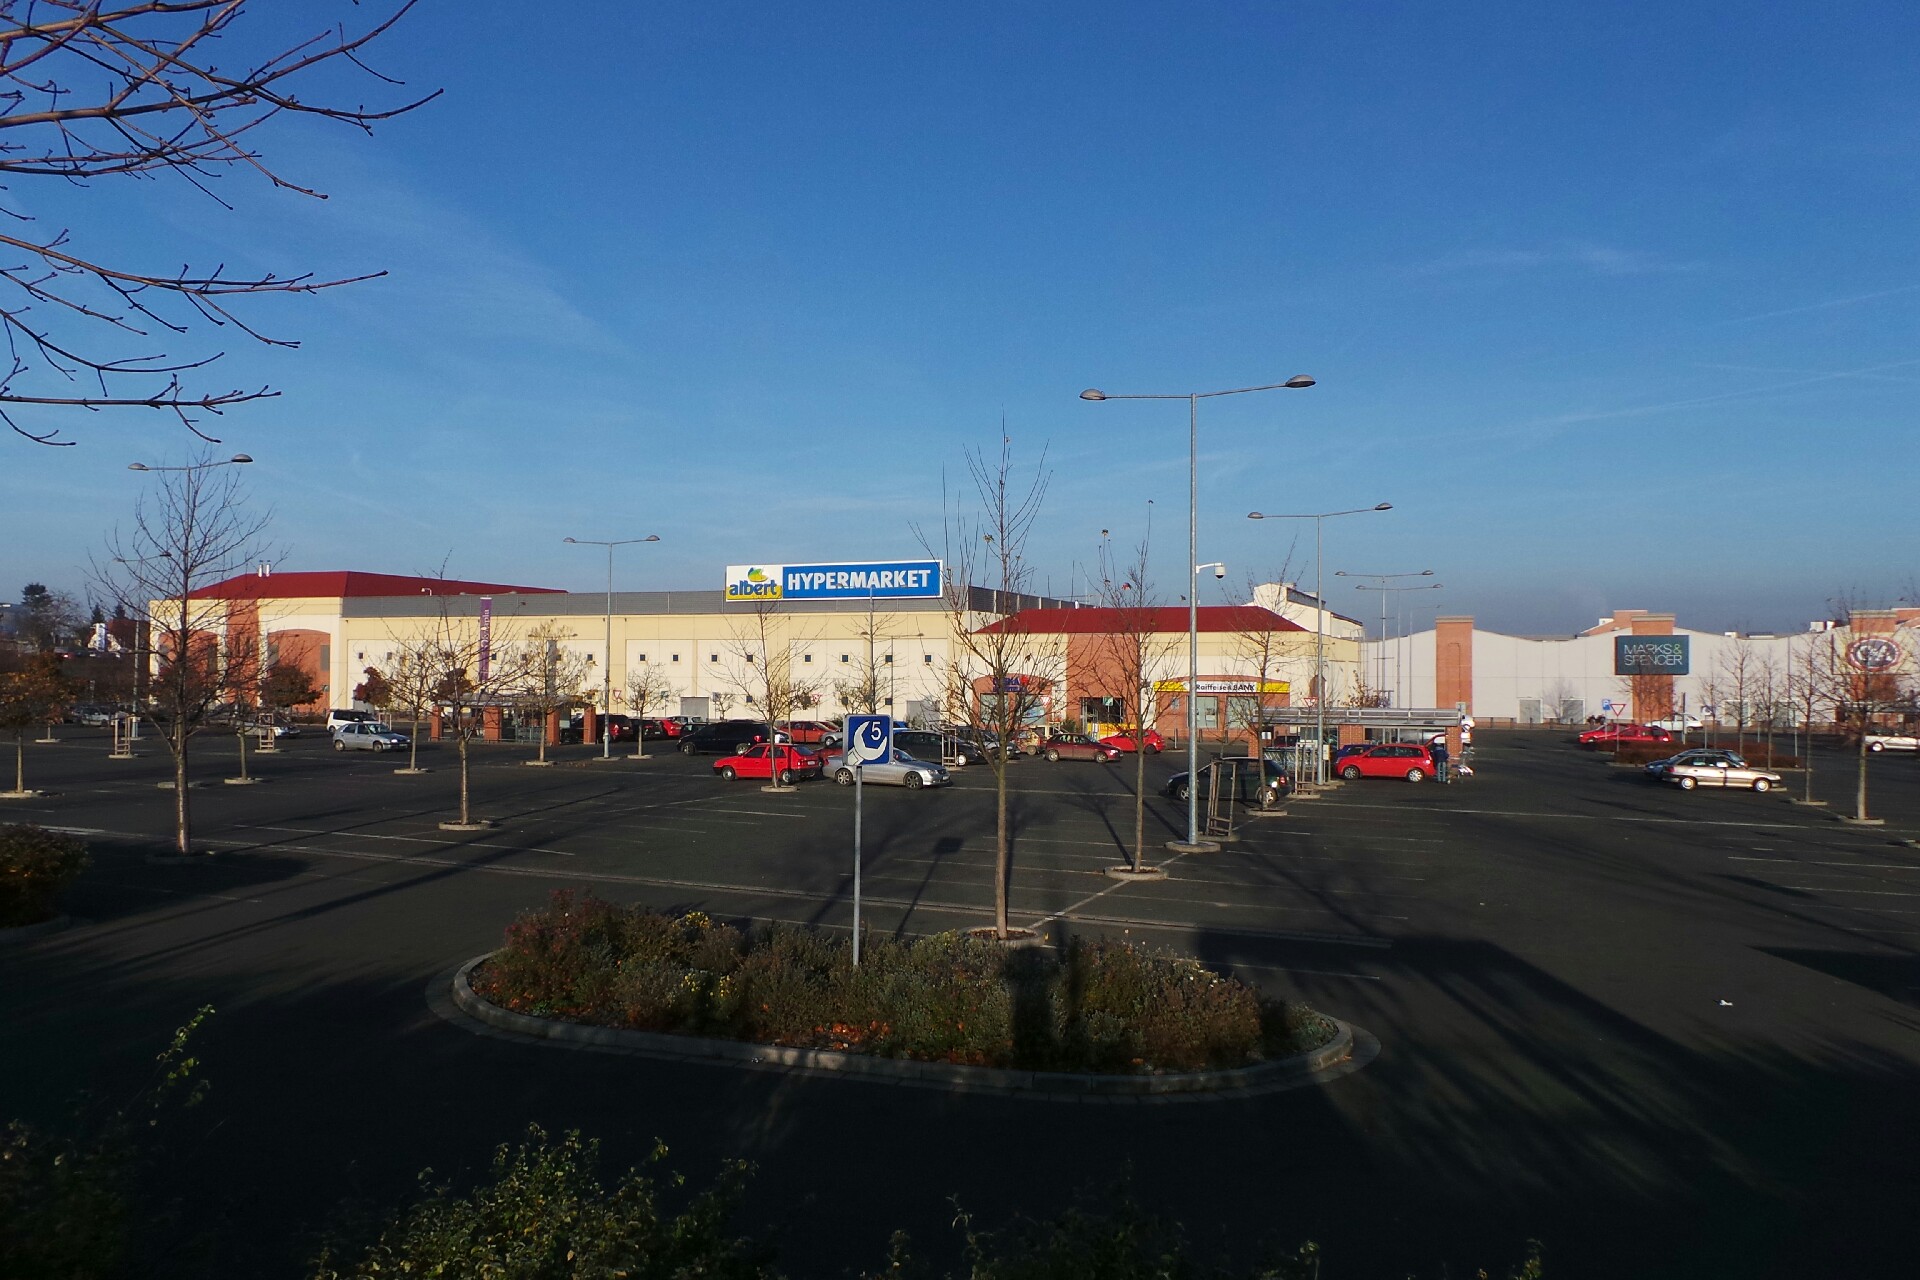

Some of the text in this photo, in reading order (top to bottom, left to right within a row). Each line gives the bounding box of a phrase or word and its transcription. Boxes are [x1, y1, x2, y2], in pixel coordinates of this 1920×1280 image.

[729, 579, 777, 596] albert
[788, 569, 932, 591] HYPERMARKET
[1624, 643, 1682, 655] MARKS &
[1624, 654, 1683, 666] SPENCER
[870, 721, 882, 741] 5
